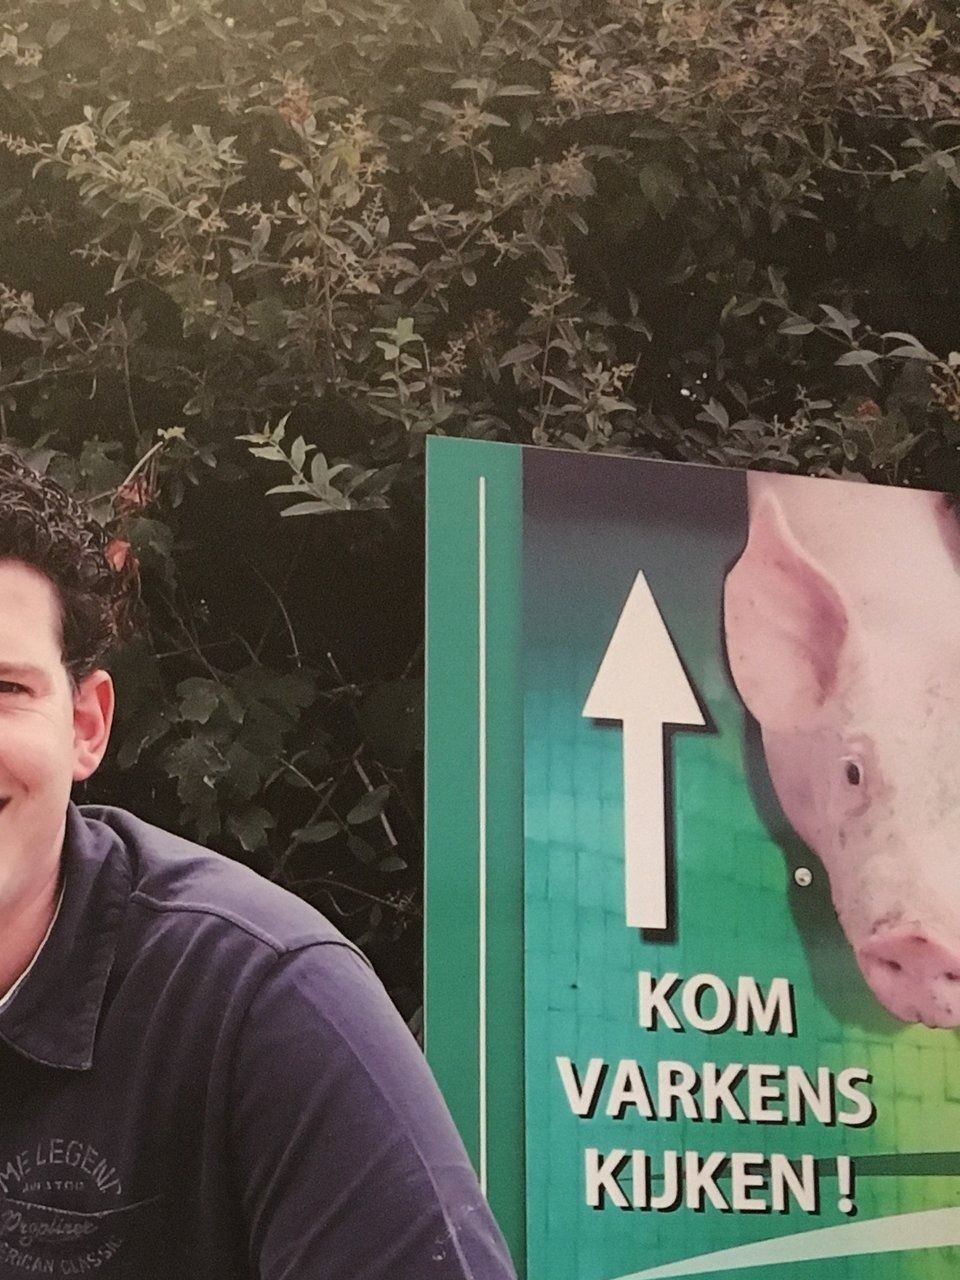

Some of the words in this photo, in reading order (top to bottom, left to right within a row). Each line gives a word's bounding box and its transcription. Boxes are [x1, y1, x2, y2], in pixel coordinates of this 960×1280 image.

[637, 971, 795, 1036] KOM
[556, 1055, 876, 1128] VARKENS
[584, 1147, 820, 1213] KIJKEN
